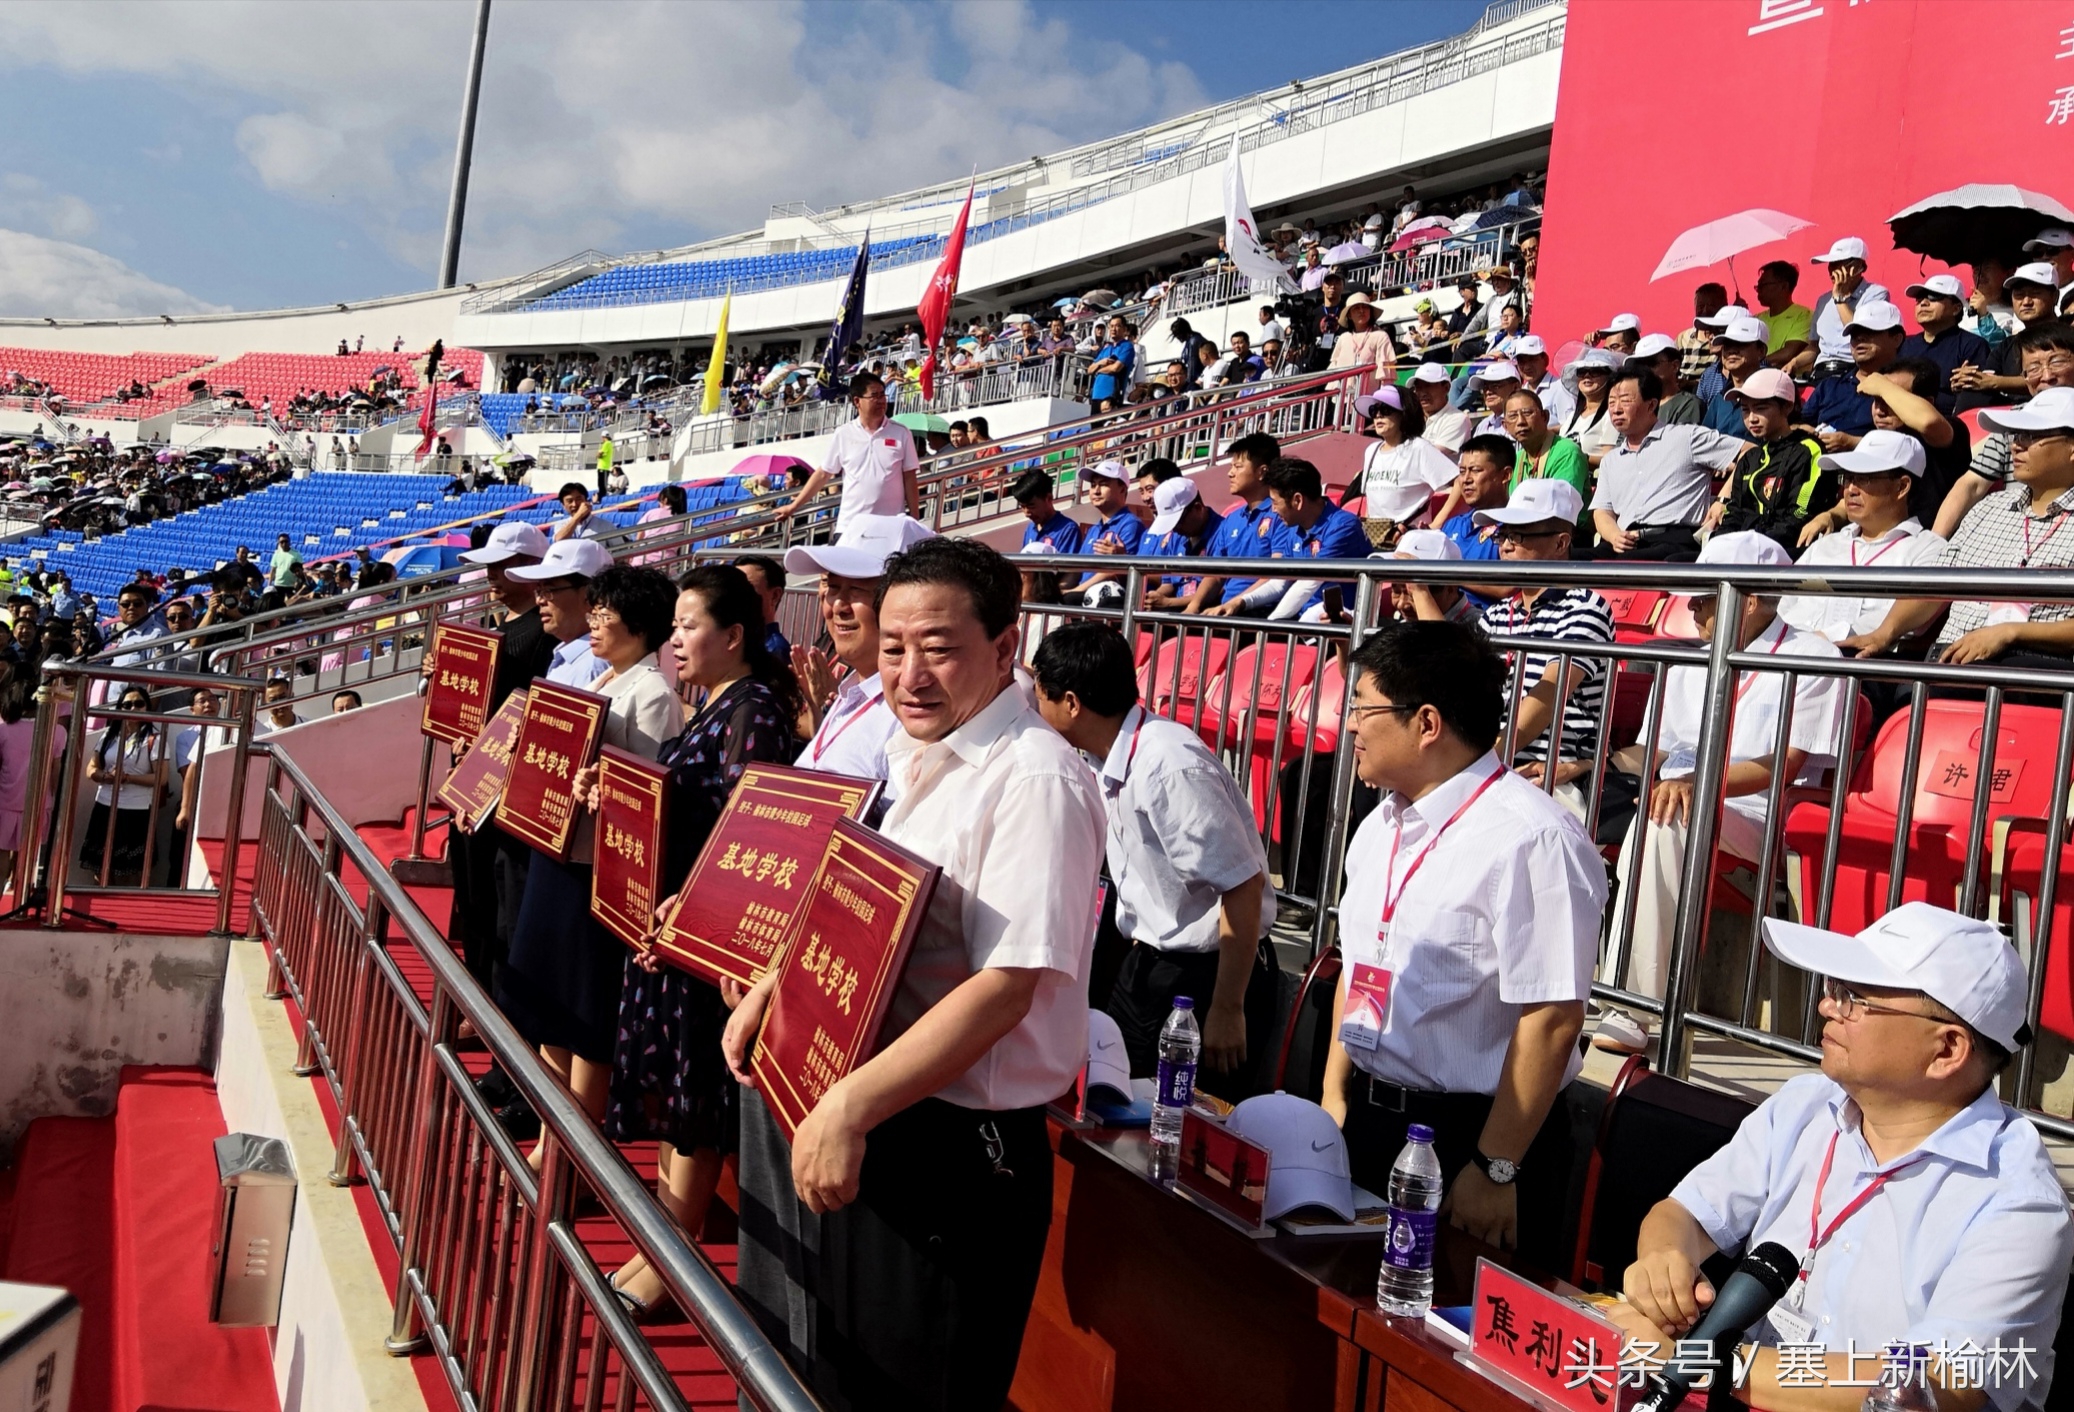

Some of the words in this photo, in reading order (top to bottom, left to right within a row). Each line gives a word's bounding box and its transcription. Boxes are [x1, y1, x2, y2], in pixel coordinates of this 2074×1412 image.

[1366, 470, 1401, 486] HOENIX
[439, 669, 479, 697] 基地学校
[523, 741, 570, 780] 基地学校
[604, 821, 645, 868] 基地学校
[717, 841, 799, 891] 基地学校
[800, 930, 859, 1016] 基地学校
[1173, 1071, 1189, 1101] 纯悦
